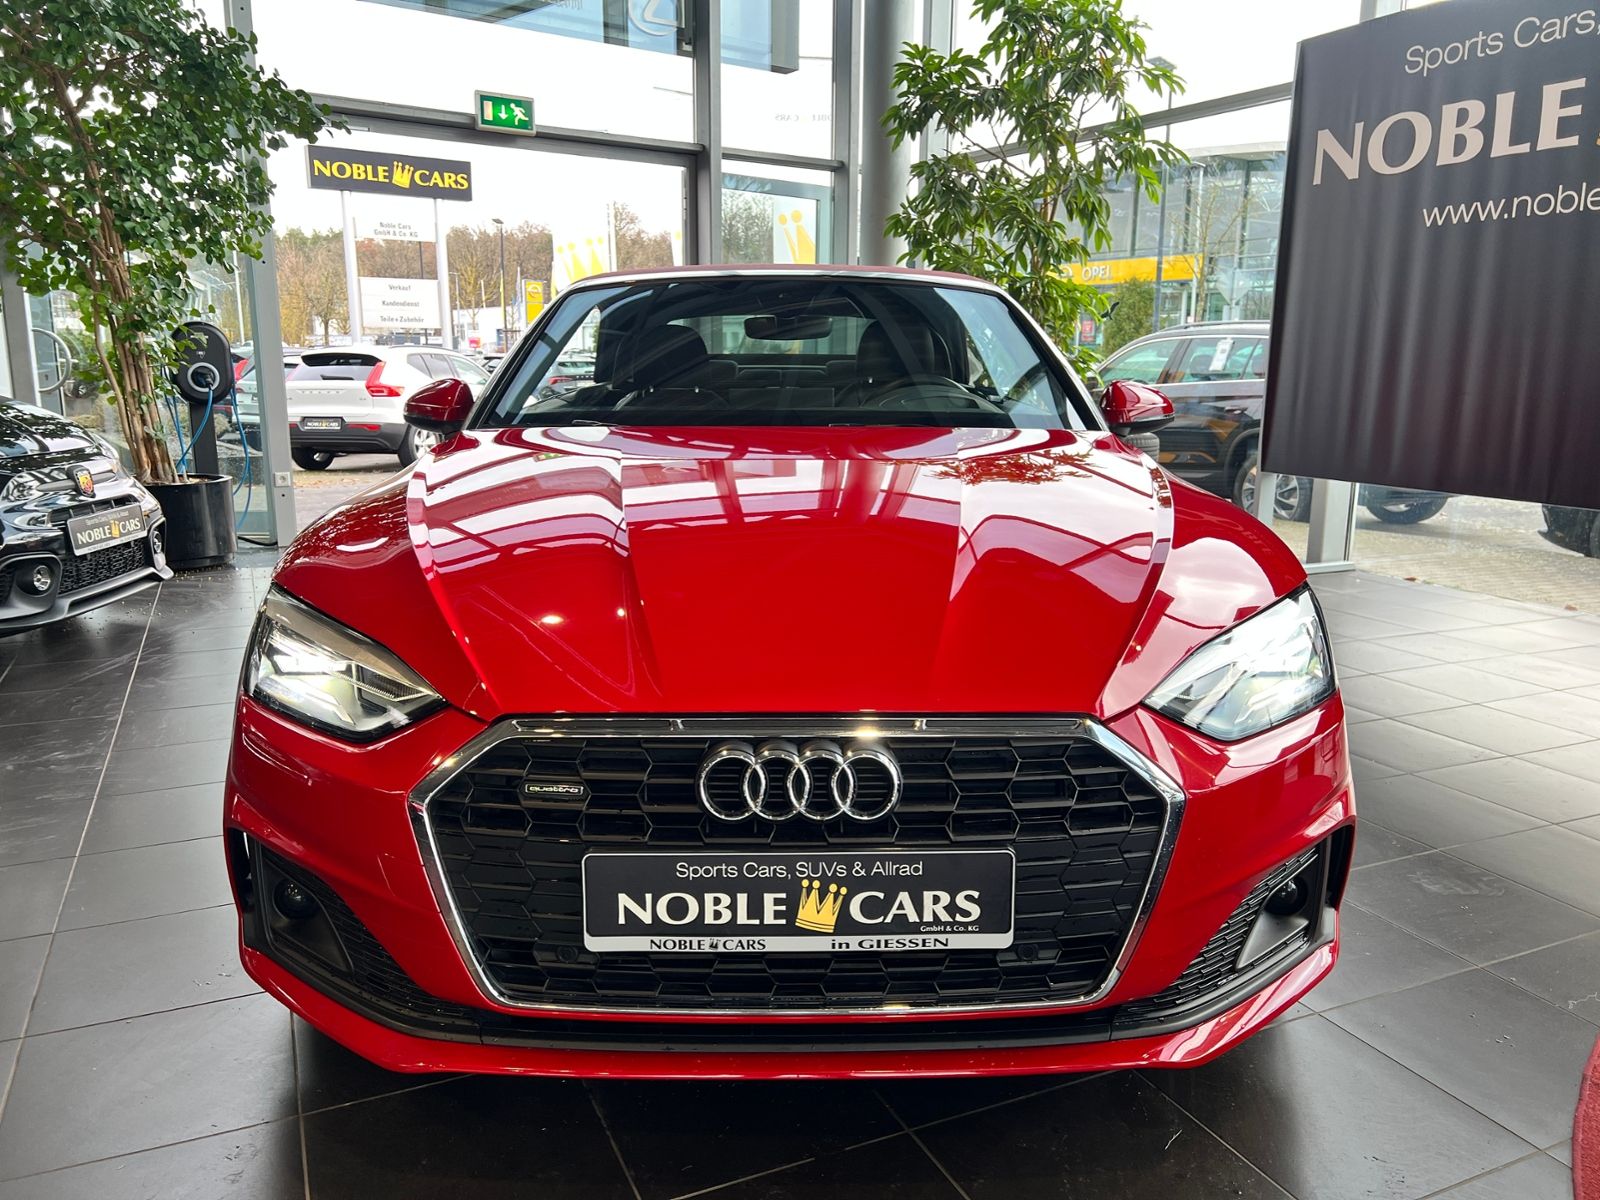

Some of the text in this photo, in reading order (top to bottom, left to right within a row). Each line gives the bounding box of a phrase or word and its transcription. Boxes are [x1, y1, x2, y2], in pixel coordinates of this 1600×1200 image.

[1405, 31, 1504, 77] Sports
[1312, 77, 1587, 186] NOBLE
[313, 159, 469, 190] NOBLE CARS
[1423, 182, 1600, 228] www.noble
[1082, 265, 1112, 280] OPEL
[76, 525, 112, 545] NOBLE
[119, 518, 141, 533] CARS
[676, 861, 923, 880] Sports Cars, SUVs & Allrad
[617, 890, 981, 925] NOBLE CARS
[650, 939, 766, 950] NOBLE CARS
[831, 938, 949, 950] in GIESSEN
